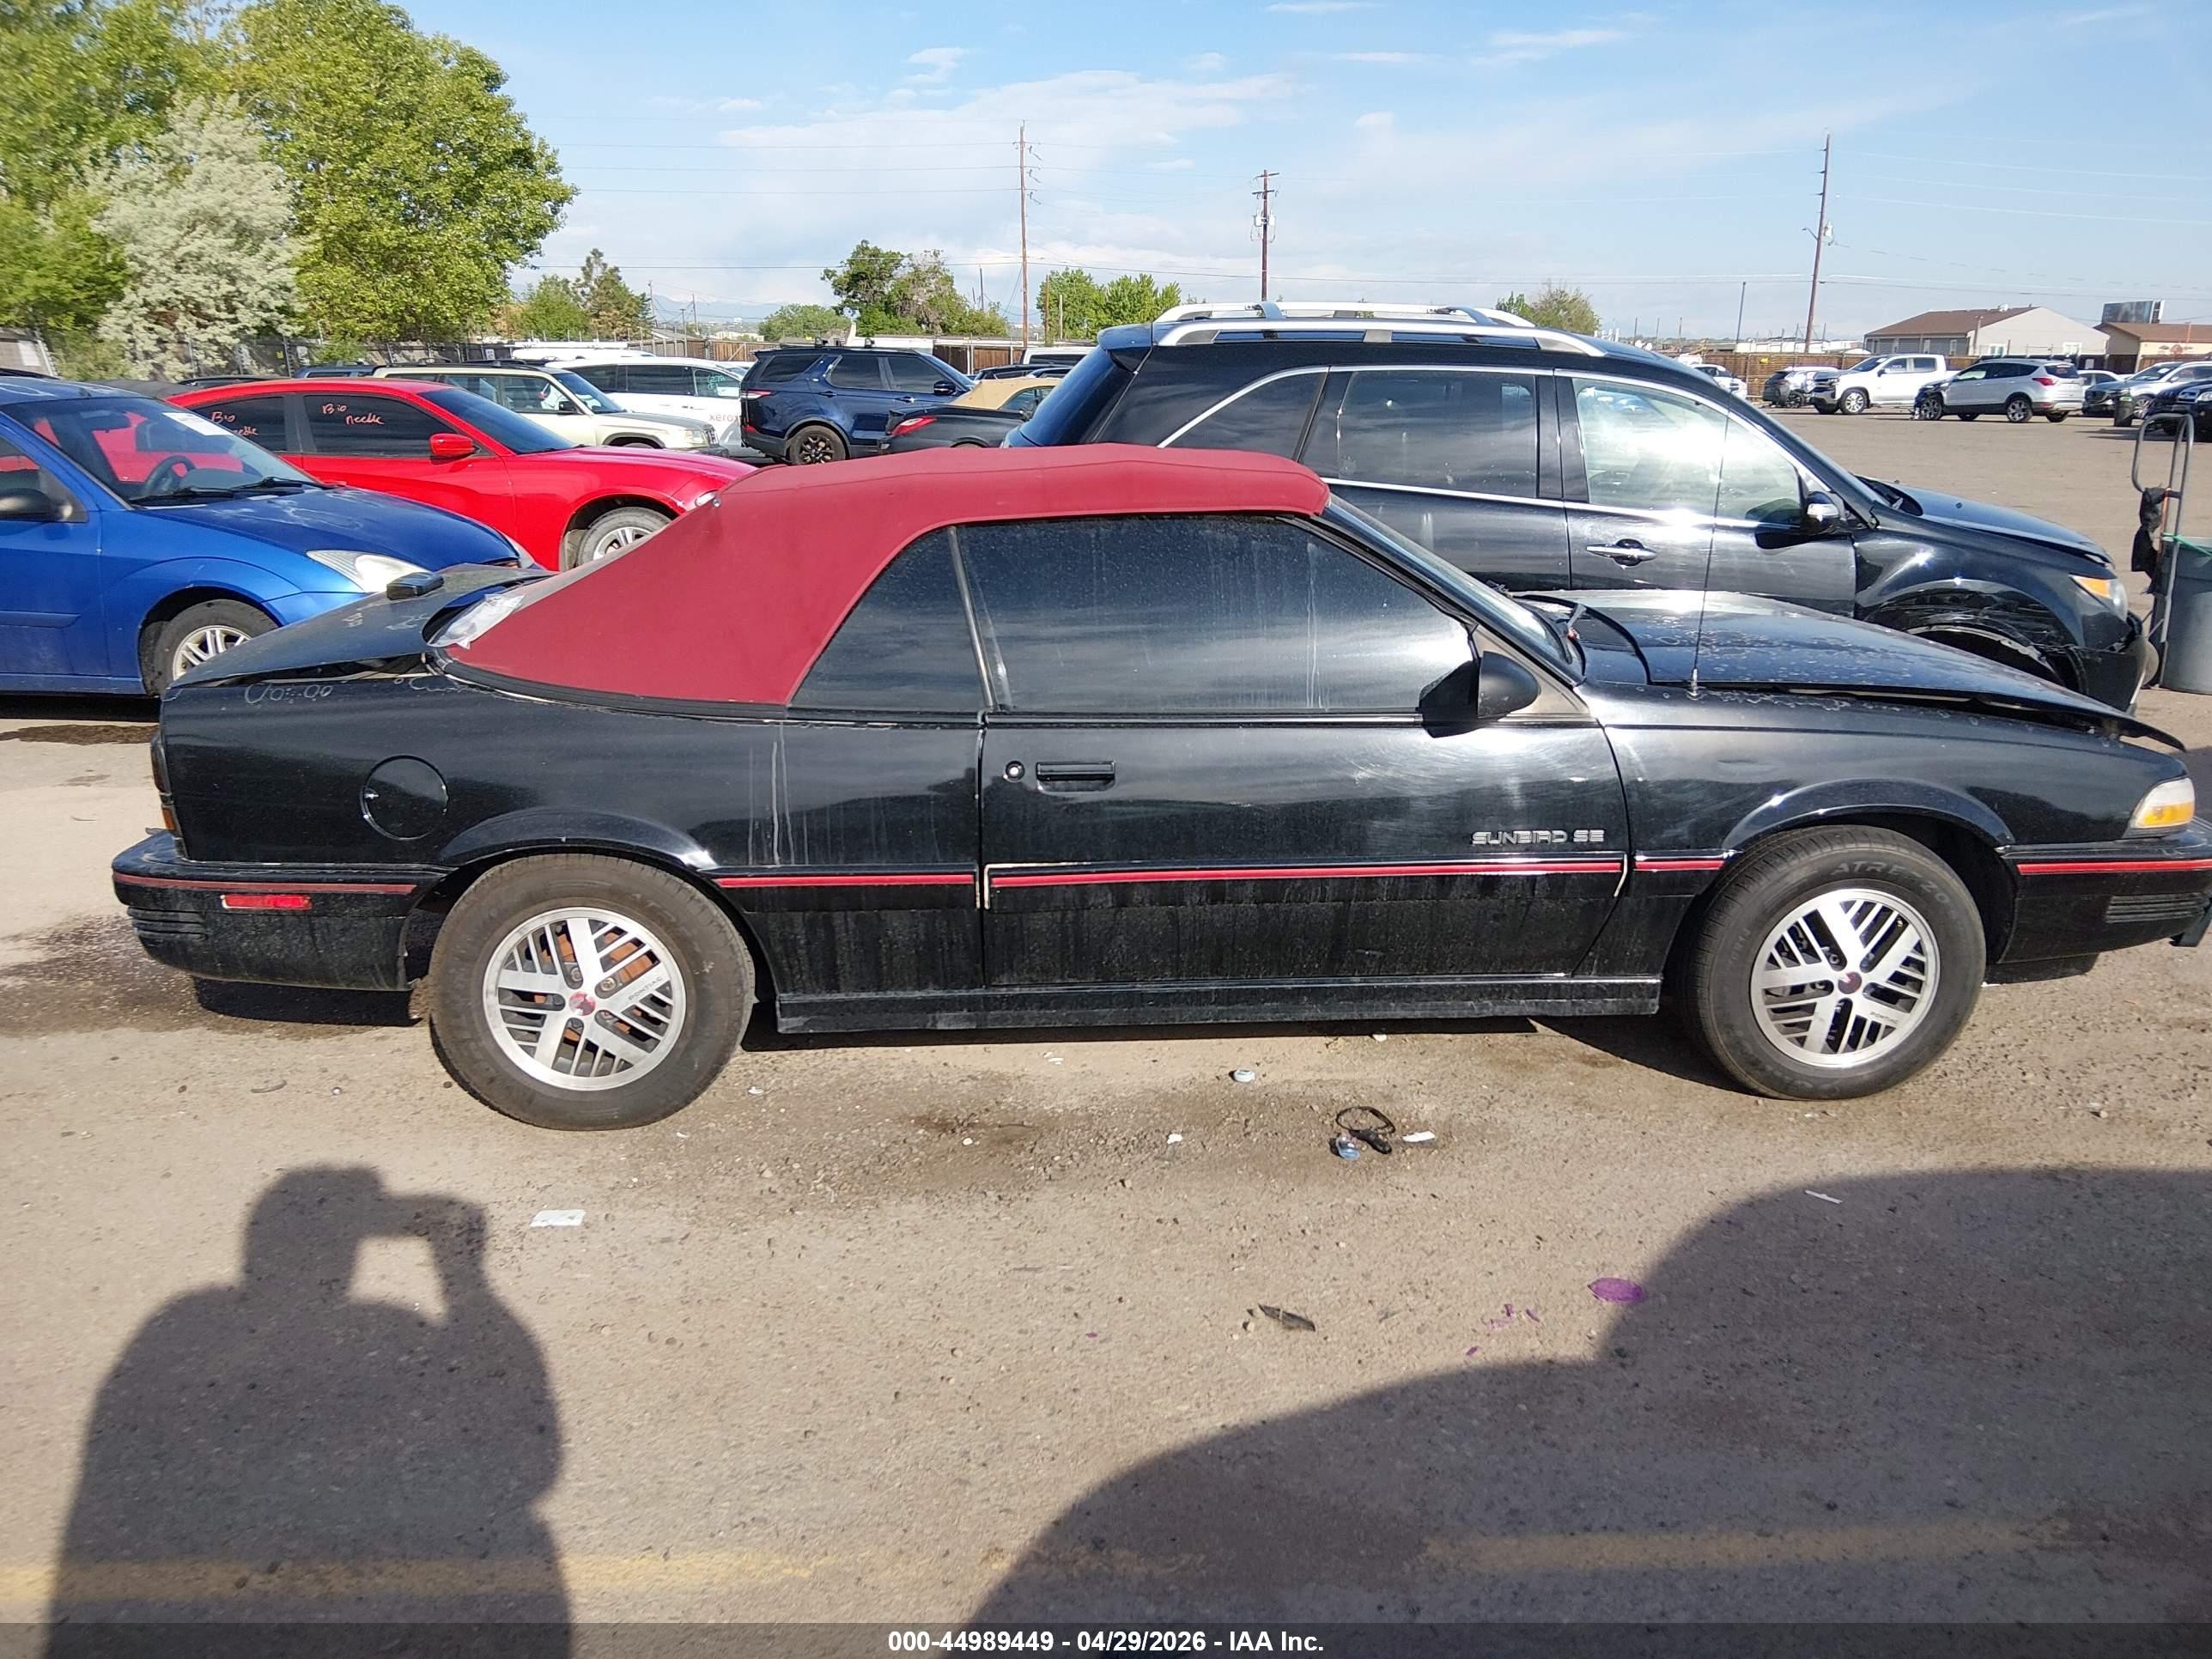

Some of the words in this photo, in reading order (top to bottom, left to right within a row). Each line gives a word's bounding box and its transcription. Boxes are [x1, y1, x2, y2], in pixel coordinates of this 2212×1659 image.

[322, 403, 347, 414] Bio
[211, 411, 235, 424] Bio
[1472, 830, 1568, 845] SUNBIRD
[1573, 830, 1605, 842] SE
